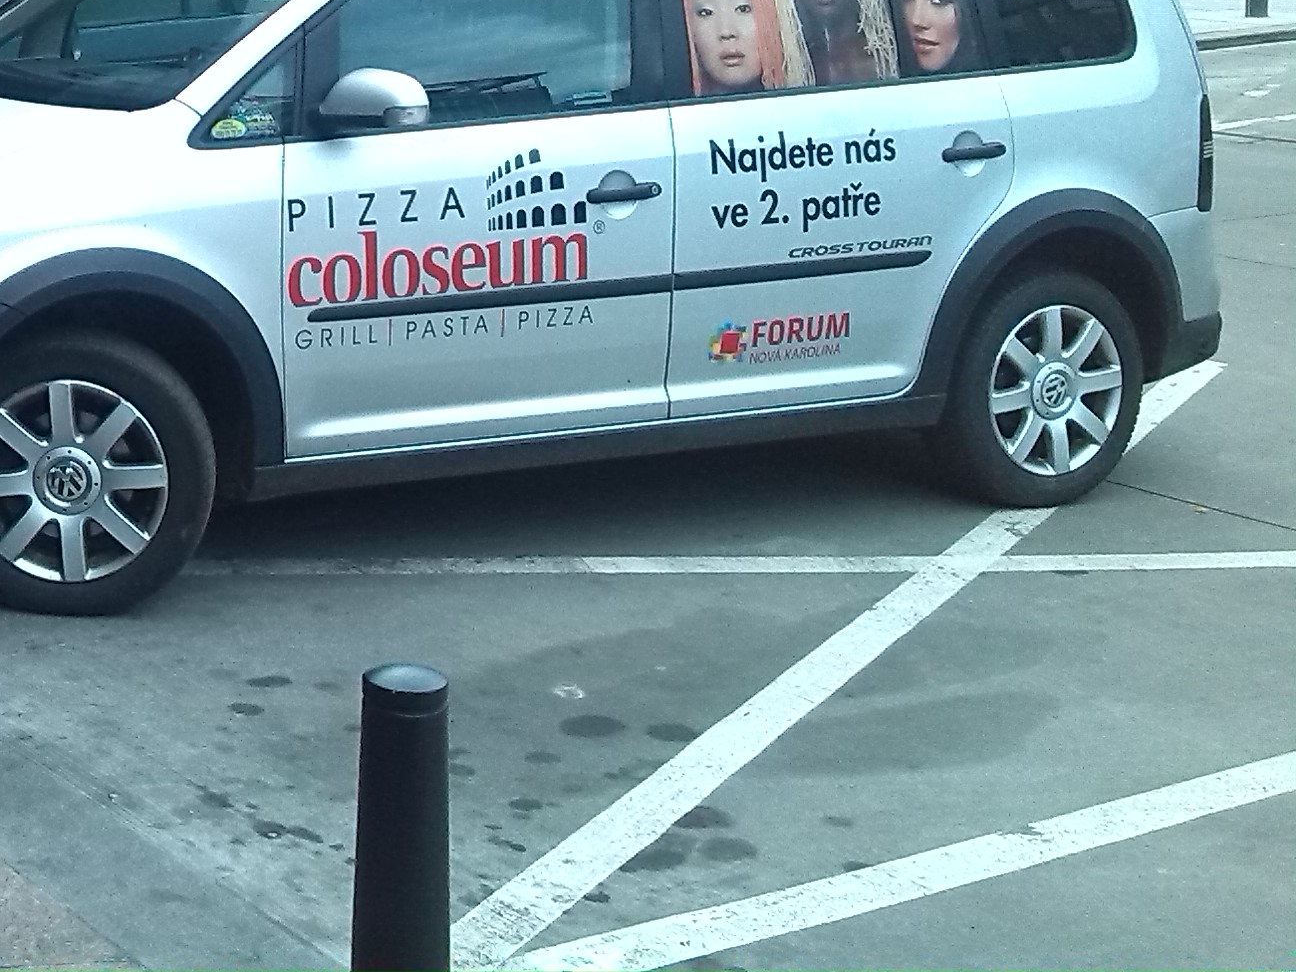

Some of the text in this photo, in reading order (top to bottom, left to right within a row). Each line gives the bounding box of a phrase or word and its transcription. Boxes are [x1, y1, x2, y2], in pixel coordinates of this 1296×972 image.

[709, 128, 896, 182] Najdete nás
[287, 187, 466, 232] PIZZA
[711, 181, 881, 232] ve 2. patře
[287, 230, 589, 308] coloseum
[295, 305, 594, 350] GRILL PASTA PIZZA
[751, 312, 851, 348] FORUM
[784, 343, 841, 361] KAROLINA
